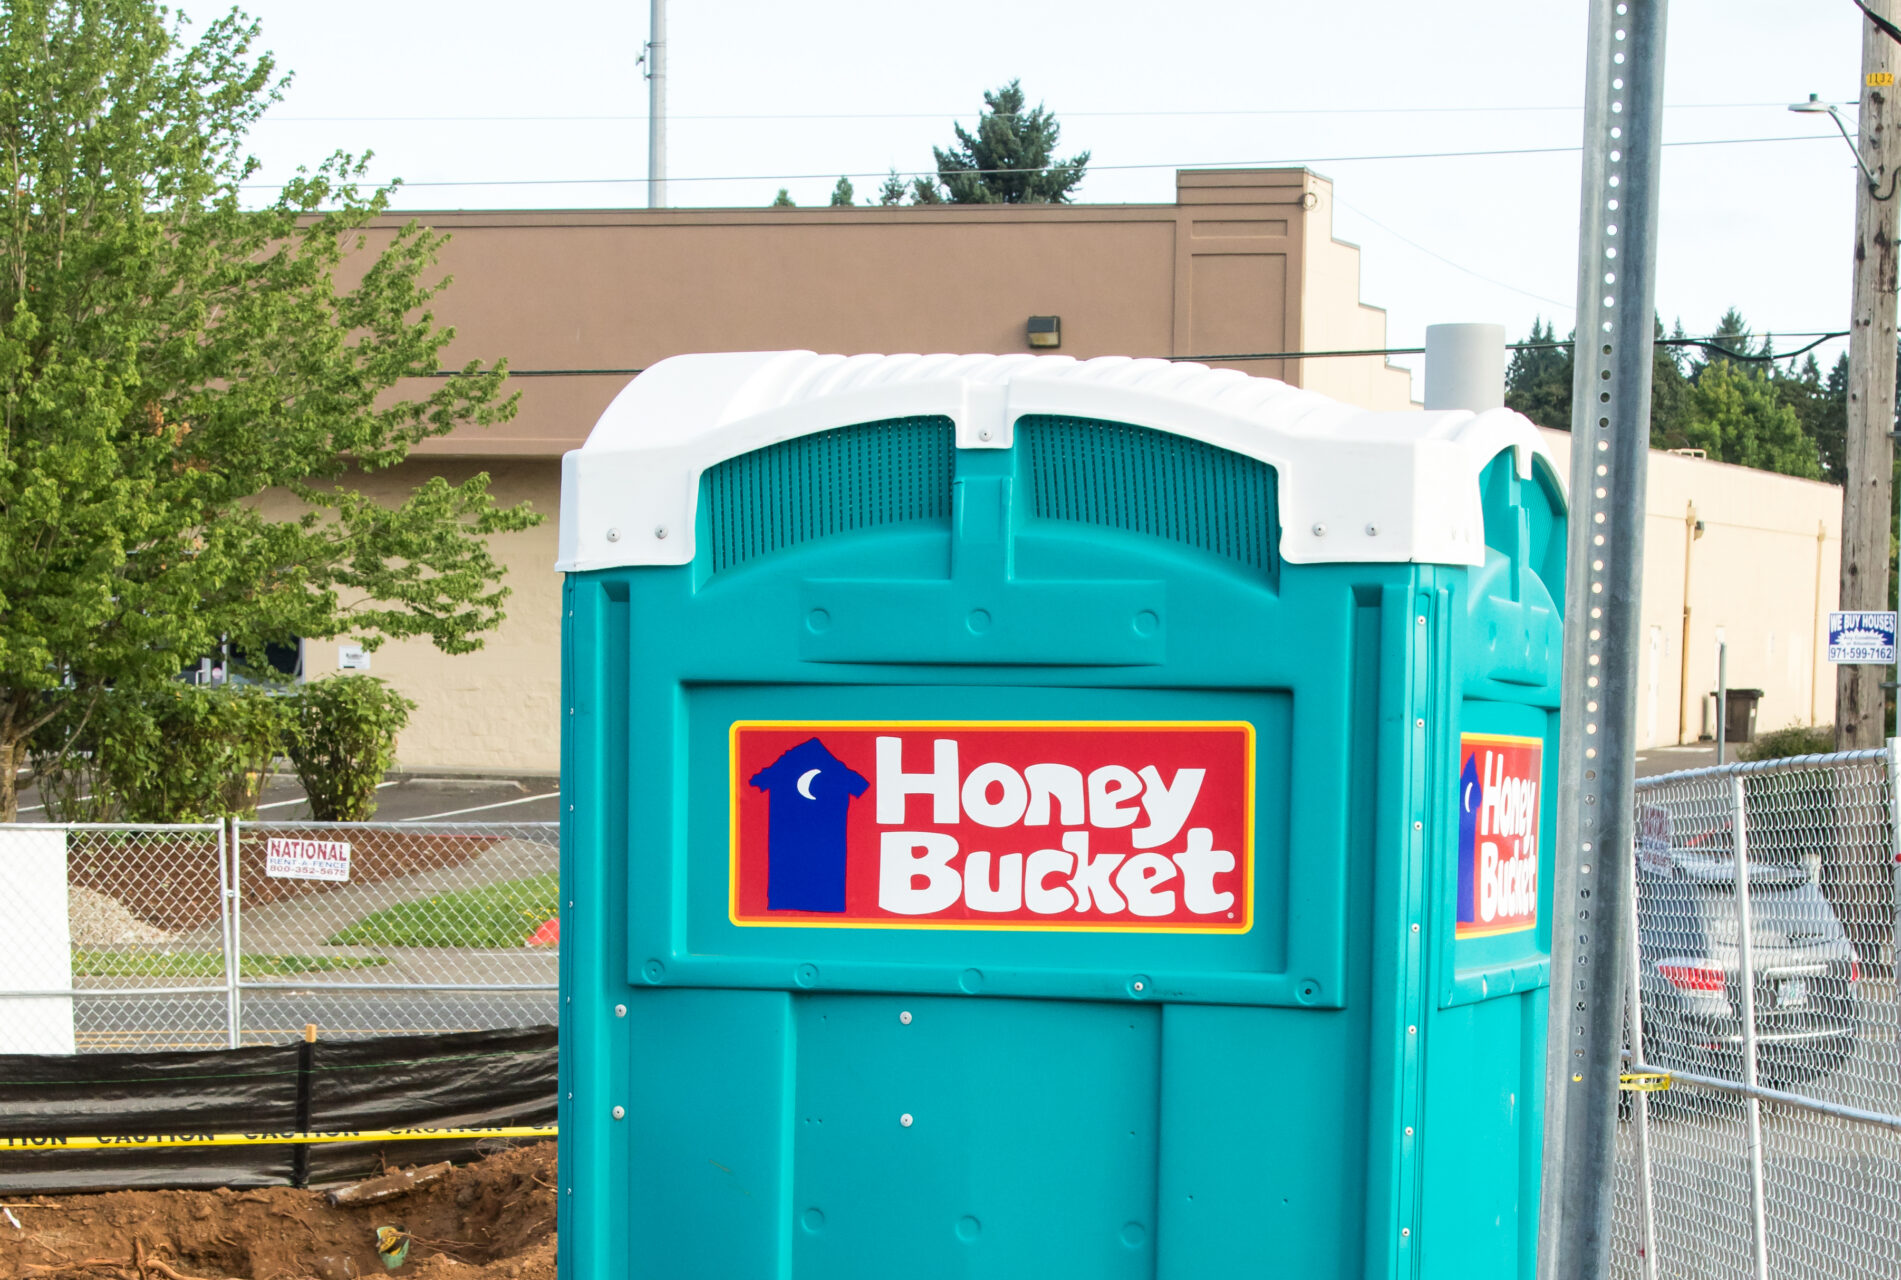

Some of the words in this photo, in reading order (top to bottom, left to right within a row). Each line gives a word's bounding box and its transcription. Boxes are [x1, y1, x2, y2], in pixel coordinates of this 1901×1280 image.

[1830, 614, 1843, 633] WE
[1844, 614, 1861, 630] BUY
[1862, 614, 1894, 633] HOUSES
[1830, 647, 1892, 659] 971-599-7162
[876, 736, 1206, 848] Honey
[1481, 750, 1536, 855] Honey
[269, 865, 347, 876] 800-352-5675
[271, 841, 347, 862] NATIONAL
[878, 827, 1235, 916] Bucket
[1480, 835, 1536, 923] Bucket
